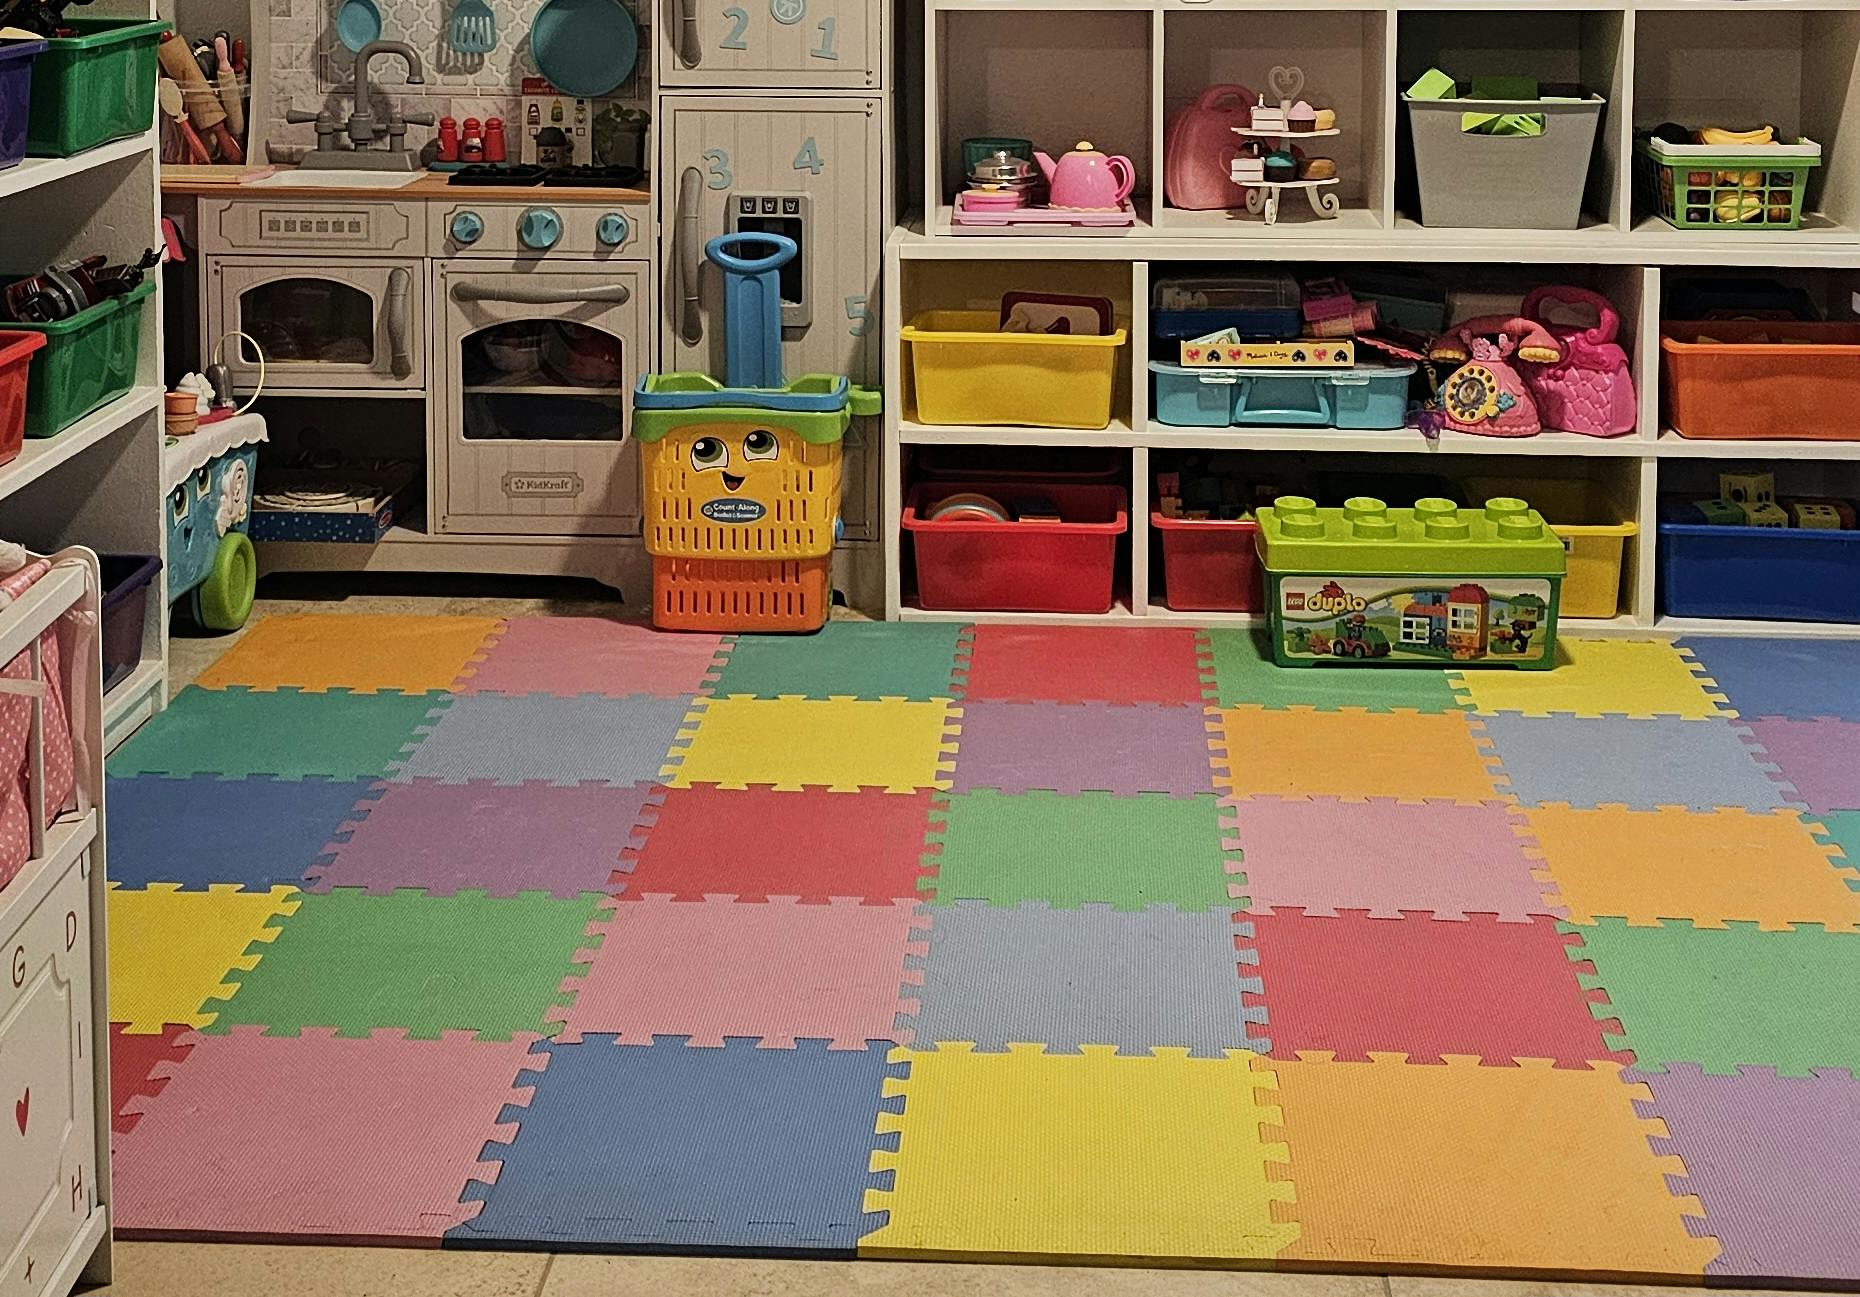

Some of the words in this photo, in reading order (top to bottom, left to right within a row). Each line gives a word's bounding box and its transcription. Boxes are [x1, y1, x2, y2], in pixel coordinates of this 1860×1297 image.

[720, 7, 749, 51] 2
[810, 16, 839, 61] 1
[703, 148, 733, 191] 3
[793, 136, 825, 175] 4
[526, 479, 569, 489] KidKraft
[1307, 592, 1367, 616] duplo
